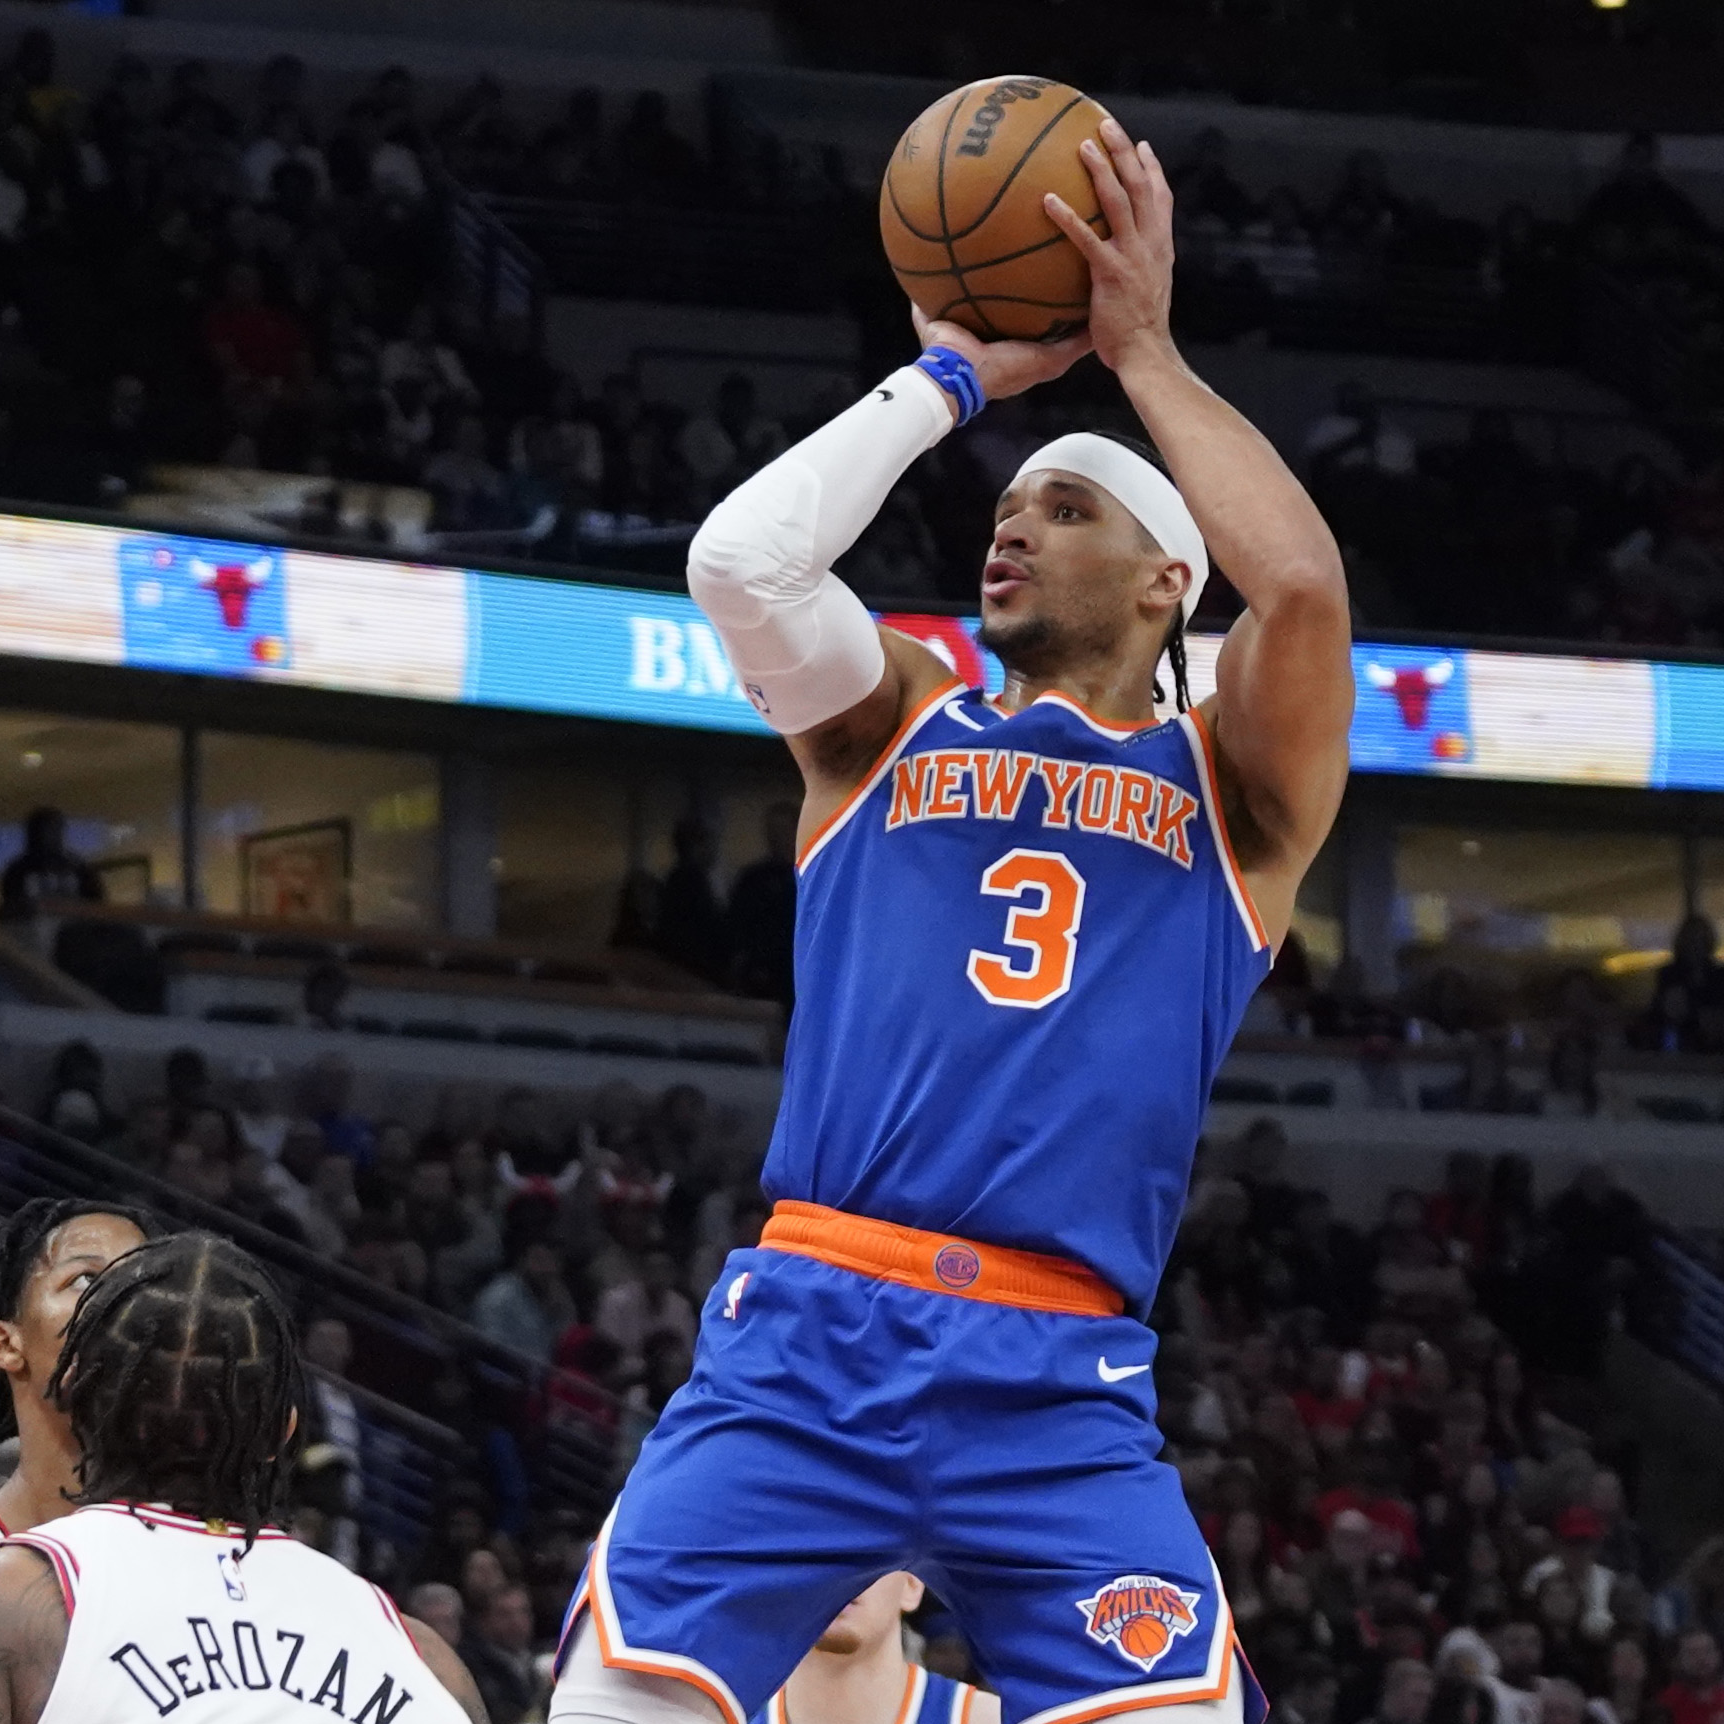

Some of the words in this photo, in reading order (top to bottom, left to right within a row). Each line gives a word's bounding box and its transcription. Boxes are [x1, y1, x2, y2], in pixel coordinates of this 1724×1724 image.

[884, 748, 1035, 834] NEW
[1040, 761, 1200, 873] YORK
[966, 847, 1087, 1010] 3
[1089, 1584, 1194, 1633] KNICKS
